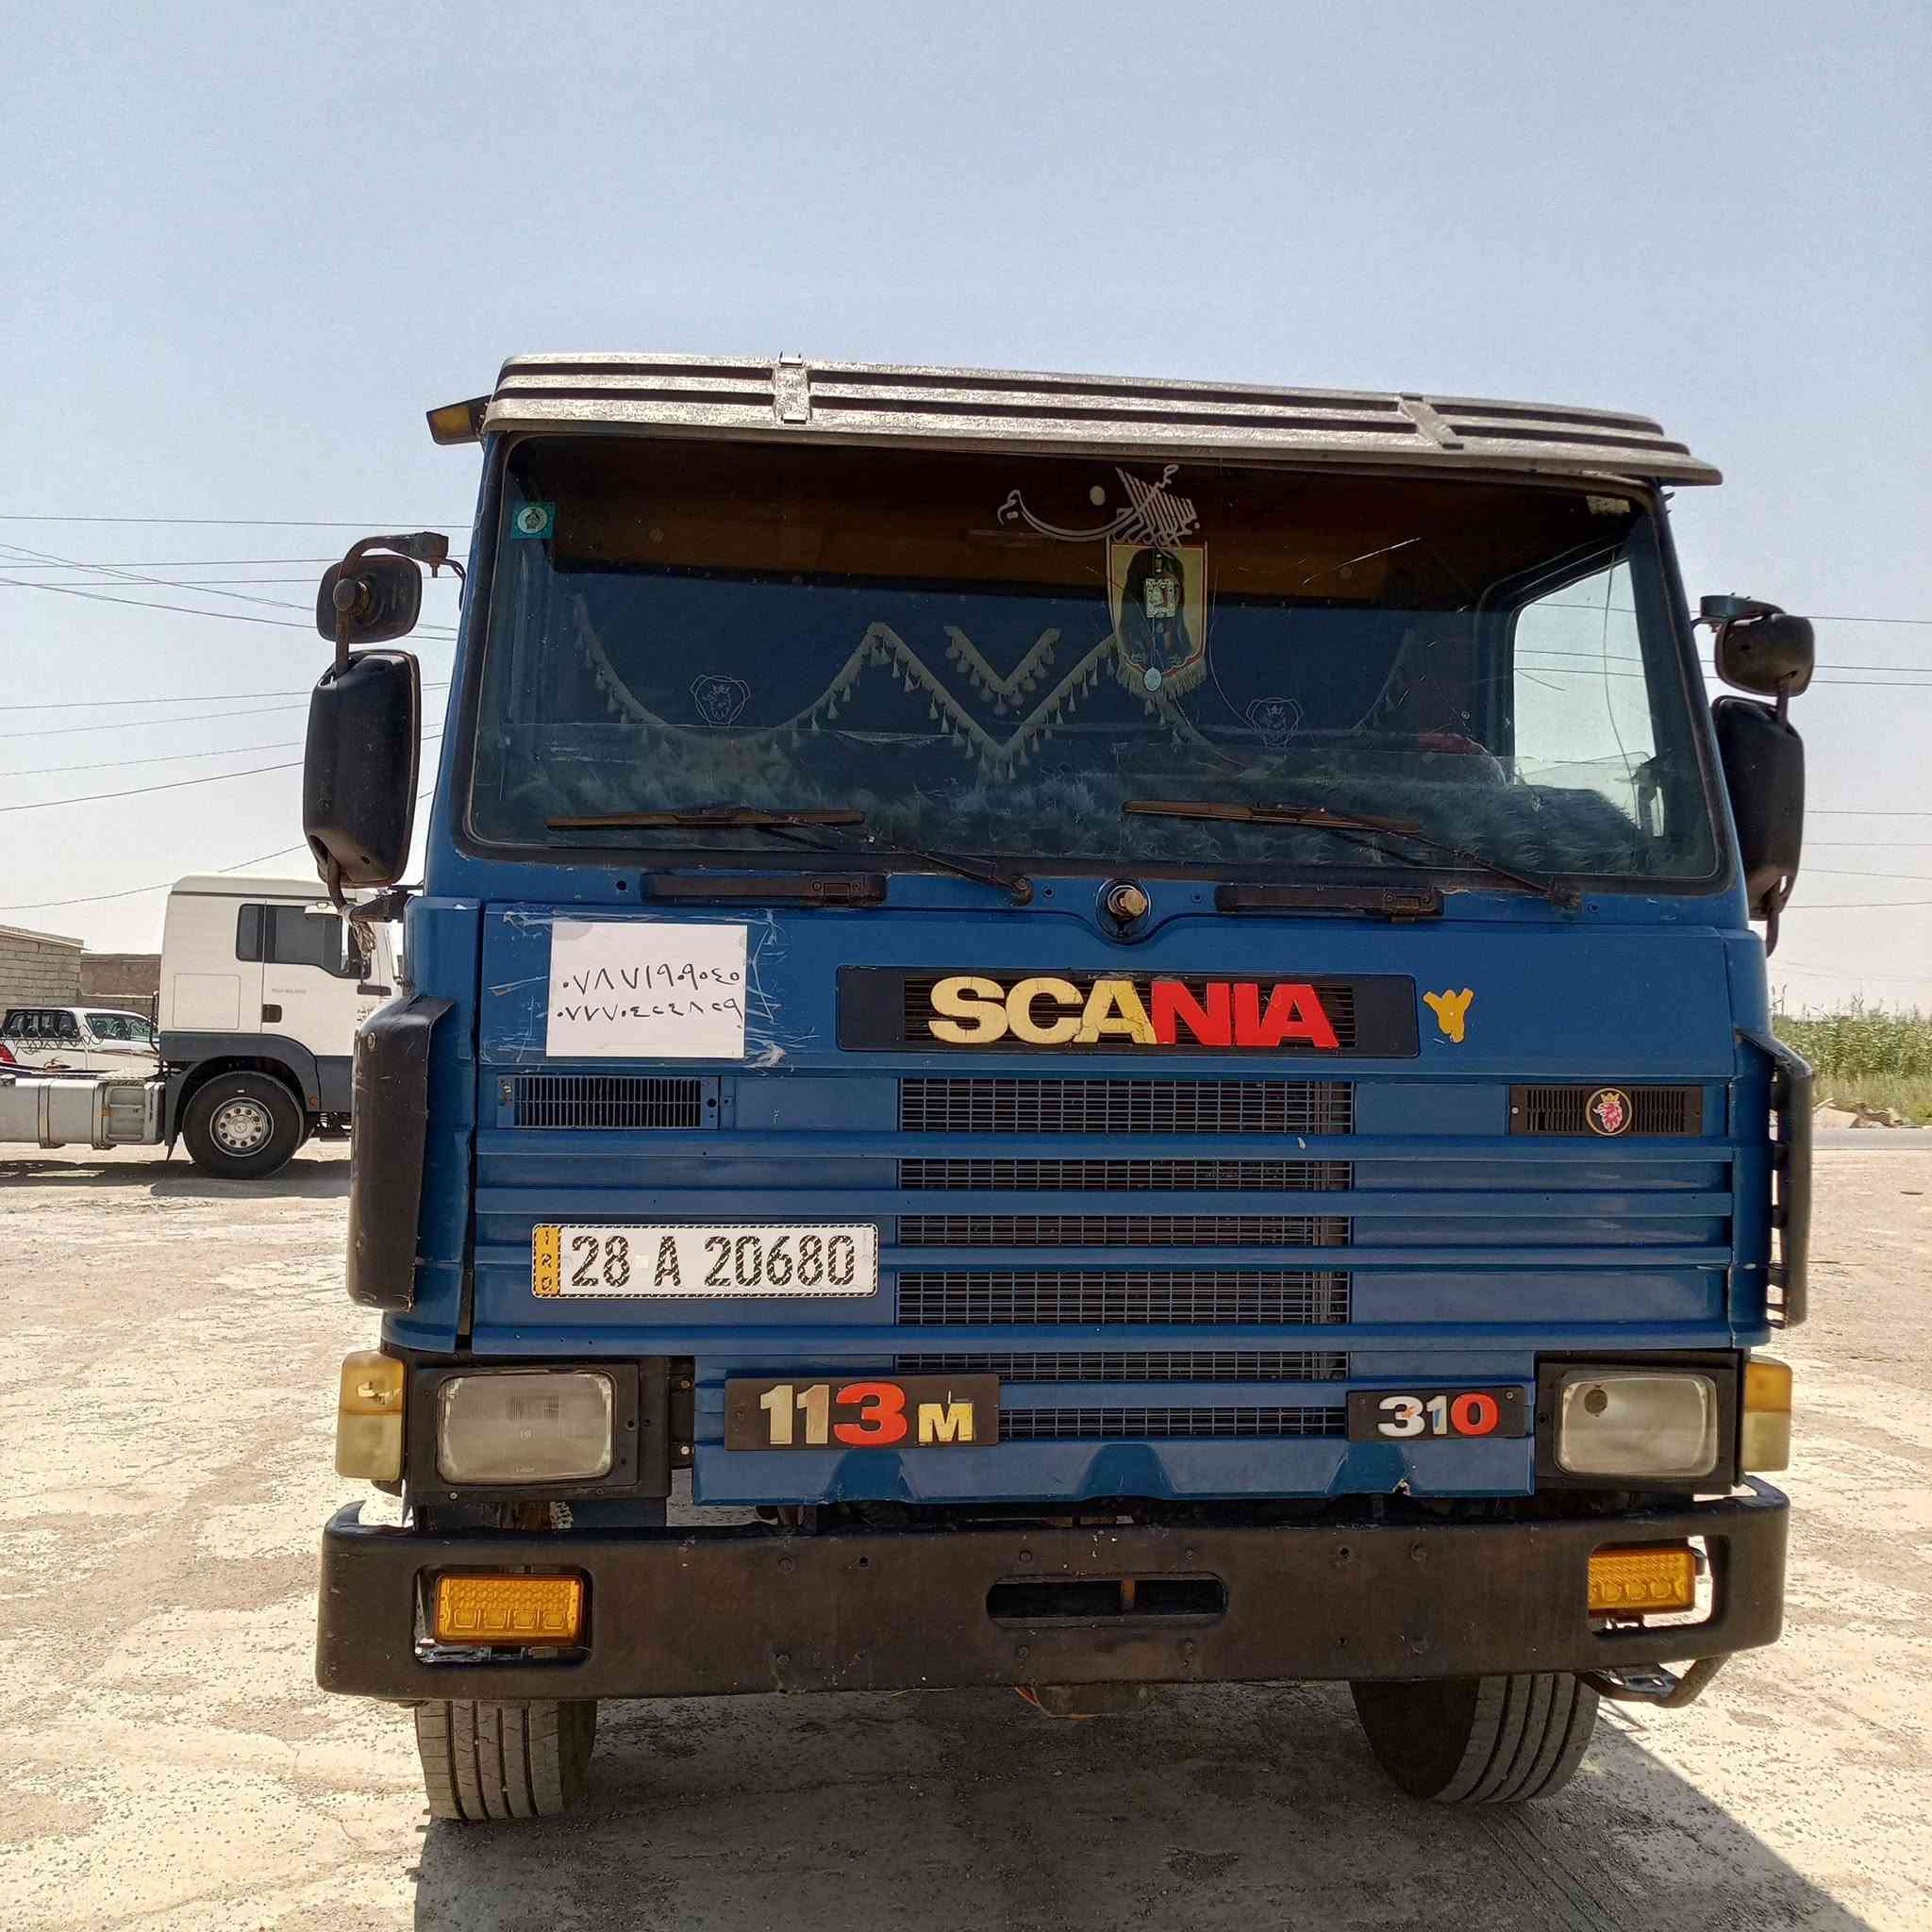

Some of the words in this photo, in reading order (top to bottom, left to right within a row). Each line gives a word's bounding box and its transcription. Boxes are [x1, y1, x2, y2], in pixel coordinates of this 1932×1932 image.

[927, 975, 1339, 1049] SCANIA
[571, 1235, 630, 1288] 28
[653, 1235, 681, 1287] A
[704, 1234, 856, 1287] 20680
[759, 1380, 908, 1446] 113
[917, 1402, 974, 1442] M
[1376, 1392, 1498, 1438] 310
